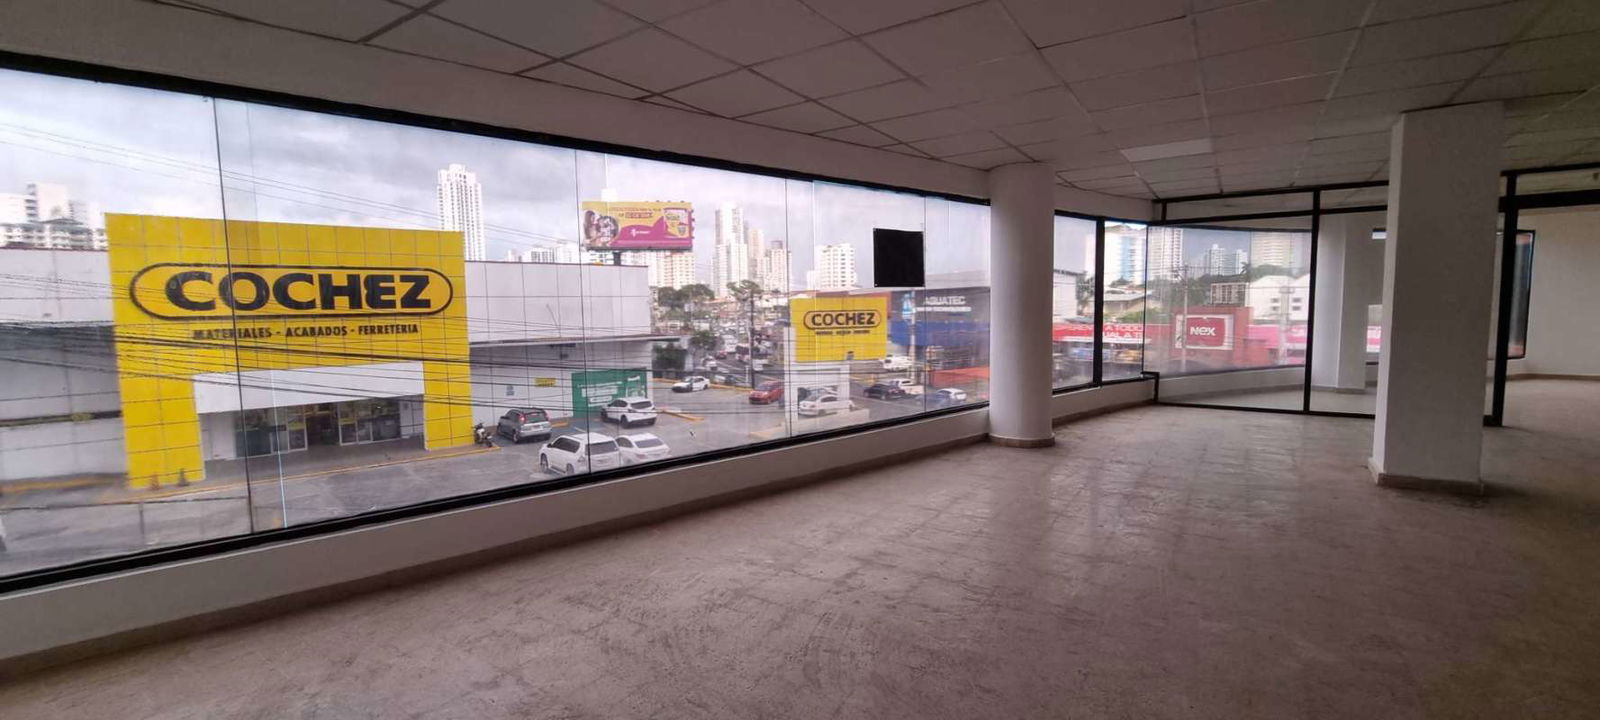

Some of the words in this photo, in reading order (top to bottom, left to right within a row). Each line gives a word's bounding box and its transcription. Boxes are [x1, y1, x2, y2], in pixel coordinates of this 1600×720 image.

[165, 270, 431, 311] COCHEZ
[811, 312, 876, 326] COCHEZ
[193, 327, 272, 340] MATERIALES
[285, 326, 348, 338] ACABADOS
[358, 324, 418, 336] FERRETERIA
